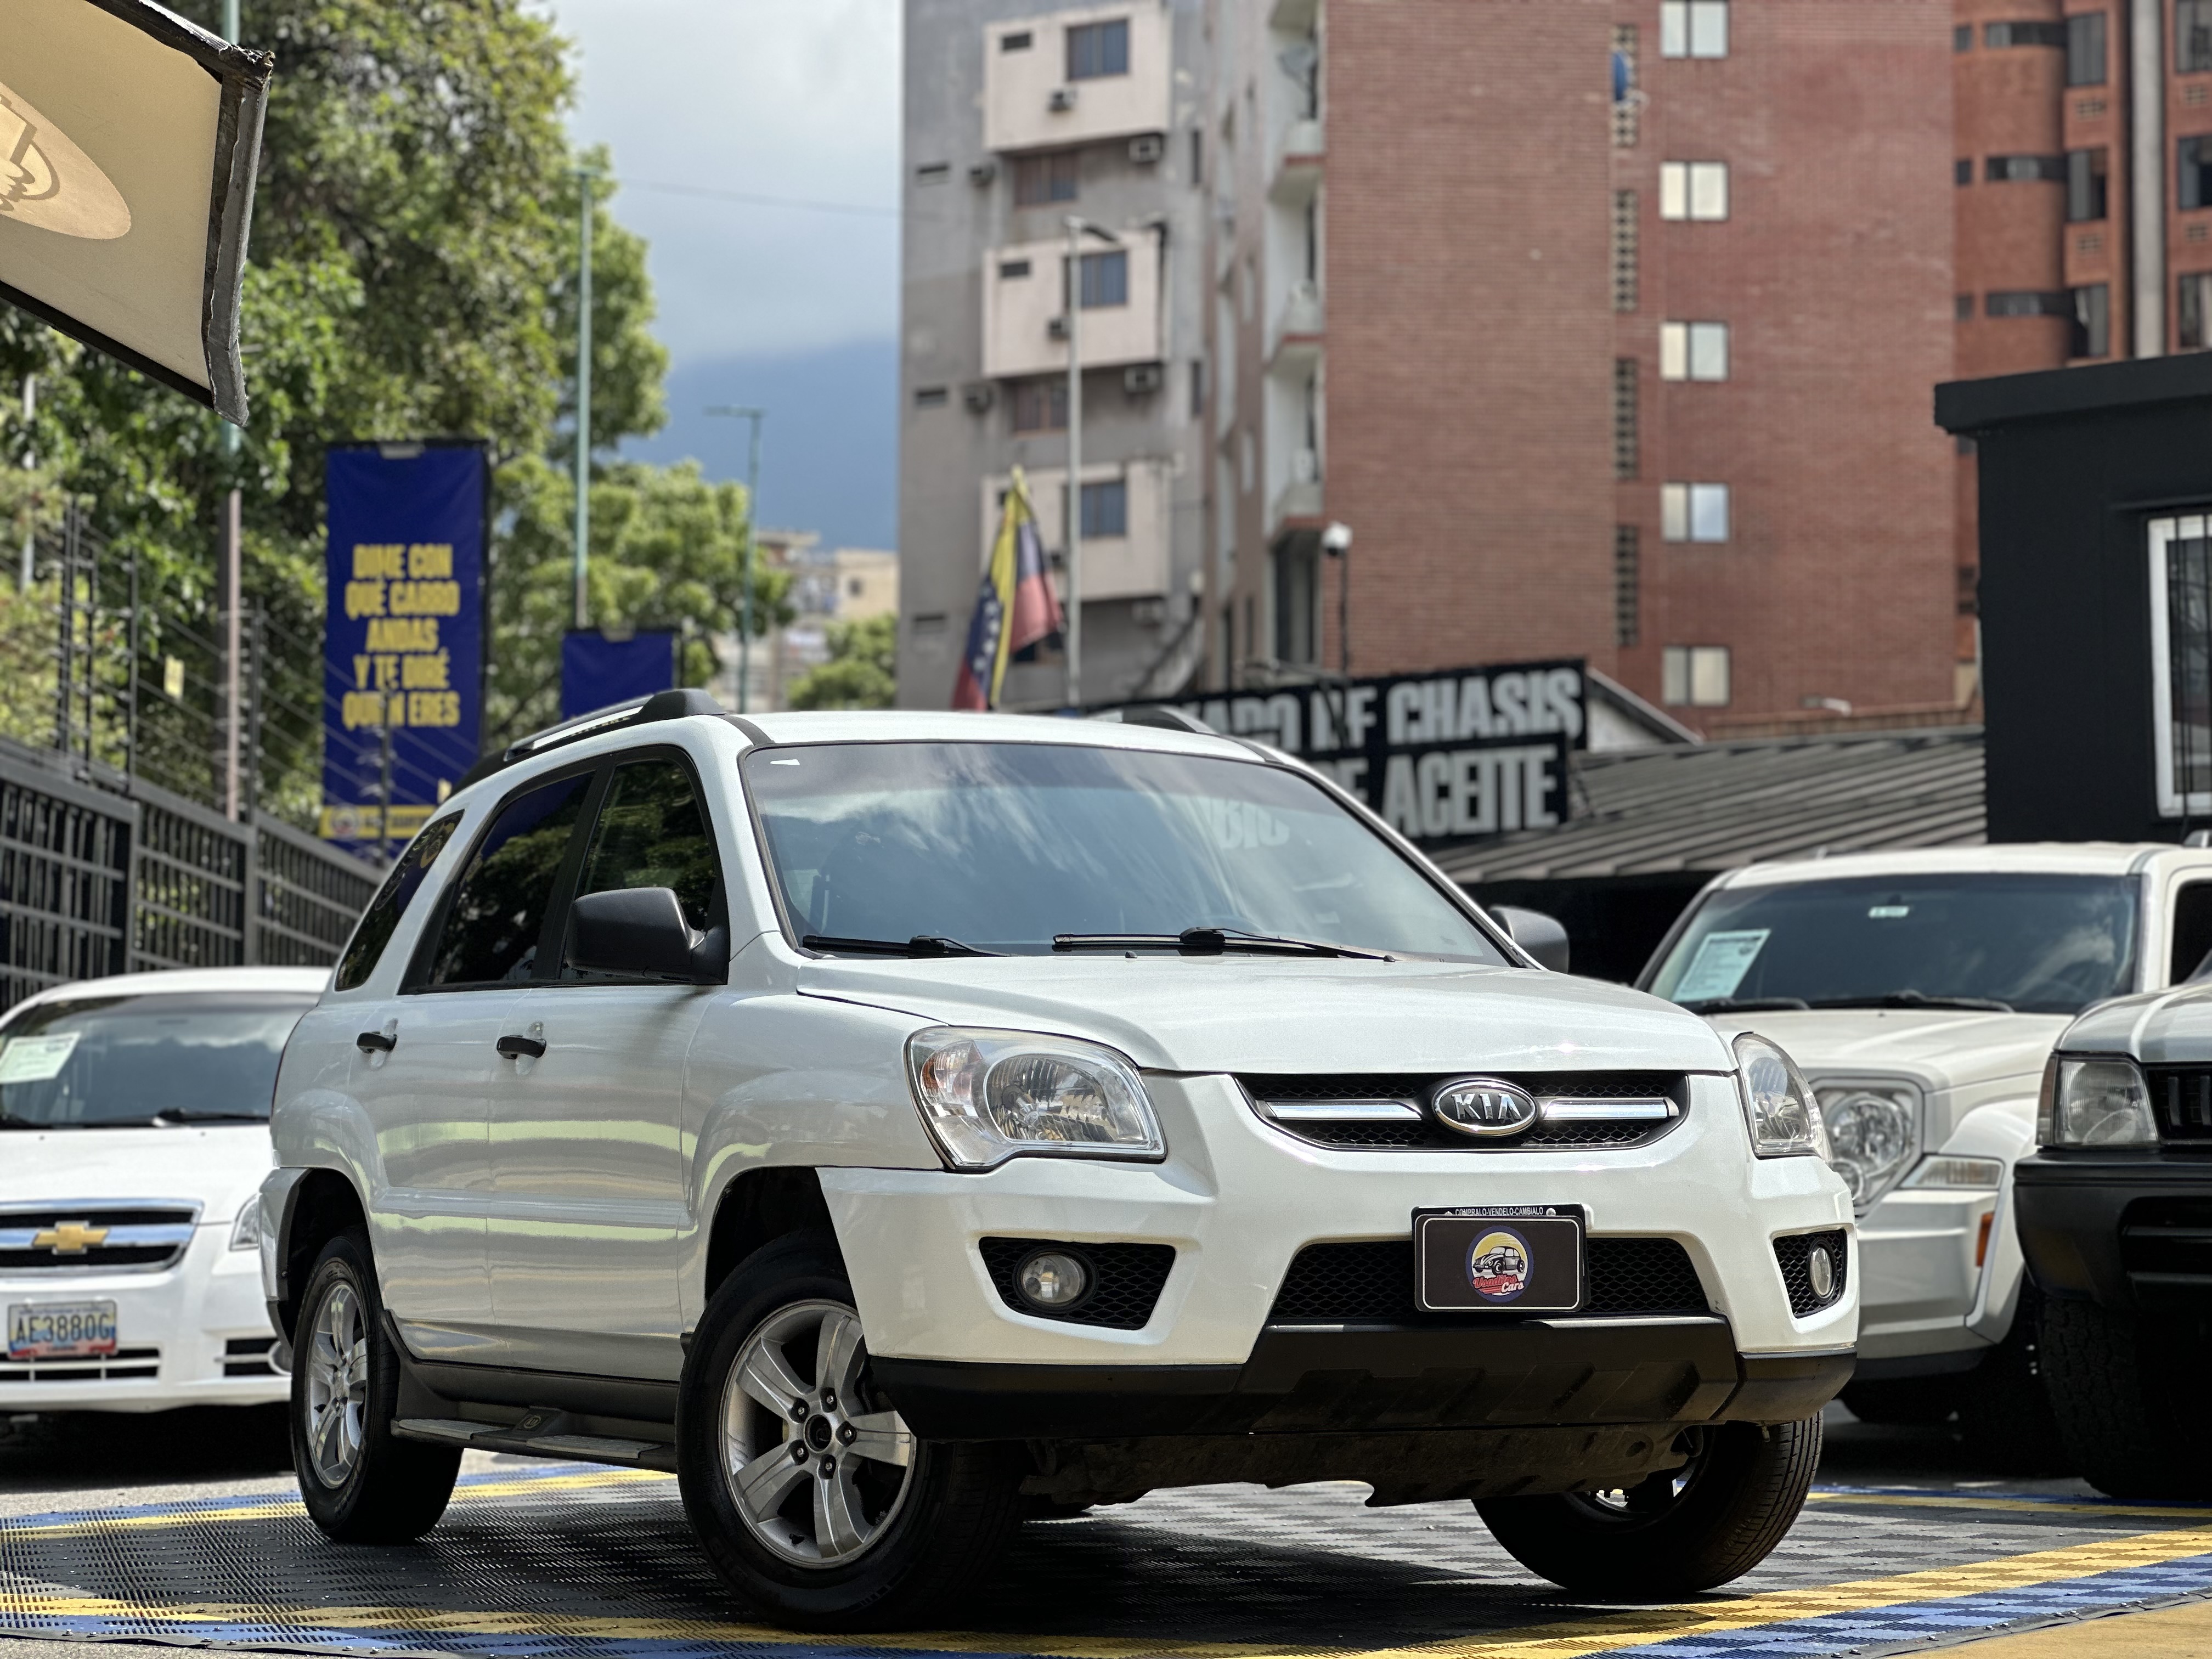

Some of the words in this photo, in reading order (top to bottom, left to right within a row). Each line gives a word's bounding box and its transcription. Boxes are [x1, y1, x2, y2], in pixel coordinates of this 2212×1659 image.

[353, 543, 407, 579] DIME
[408, 543, 453, 579] CON
[389, 580, 460, 617] CARRO
[365, 617, 438, 653] ANDAS
[352, 653, 371, 690] Y
[373, 653, 399, 690] TE
[402, 646, 450, 690] DIRÉ
[407, 690, 460, 727] ERES
[1386, 667, 1583, 744] CHASIS
[1382, 743, 1560, 838] ACEITE
[1451, 1093, 1523, 1120] KIA
[1501, 1282, 1525, 1293] Cars
[16, 1313, 111, 1343] AE3880G
